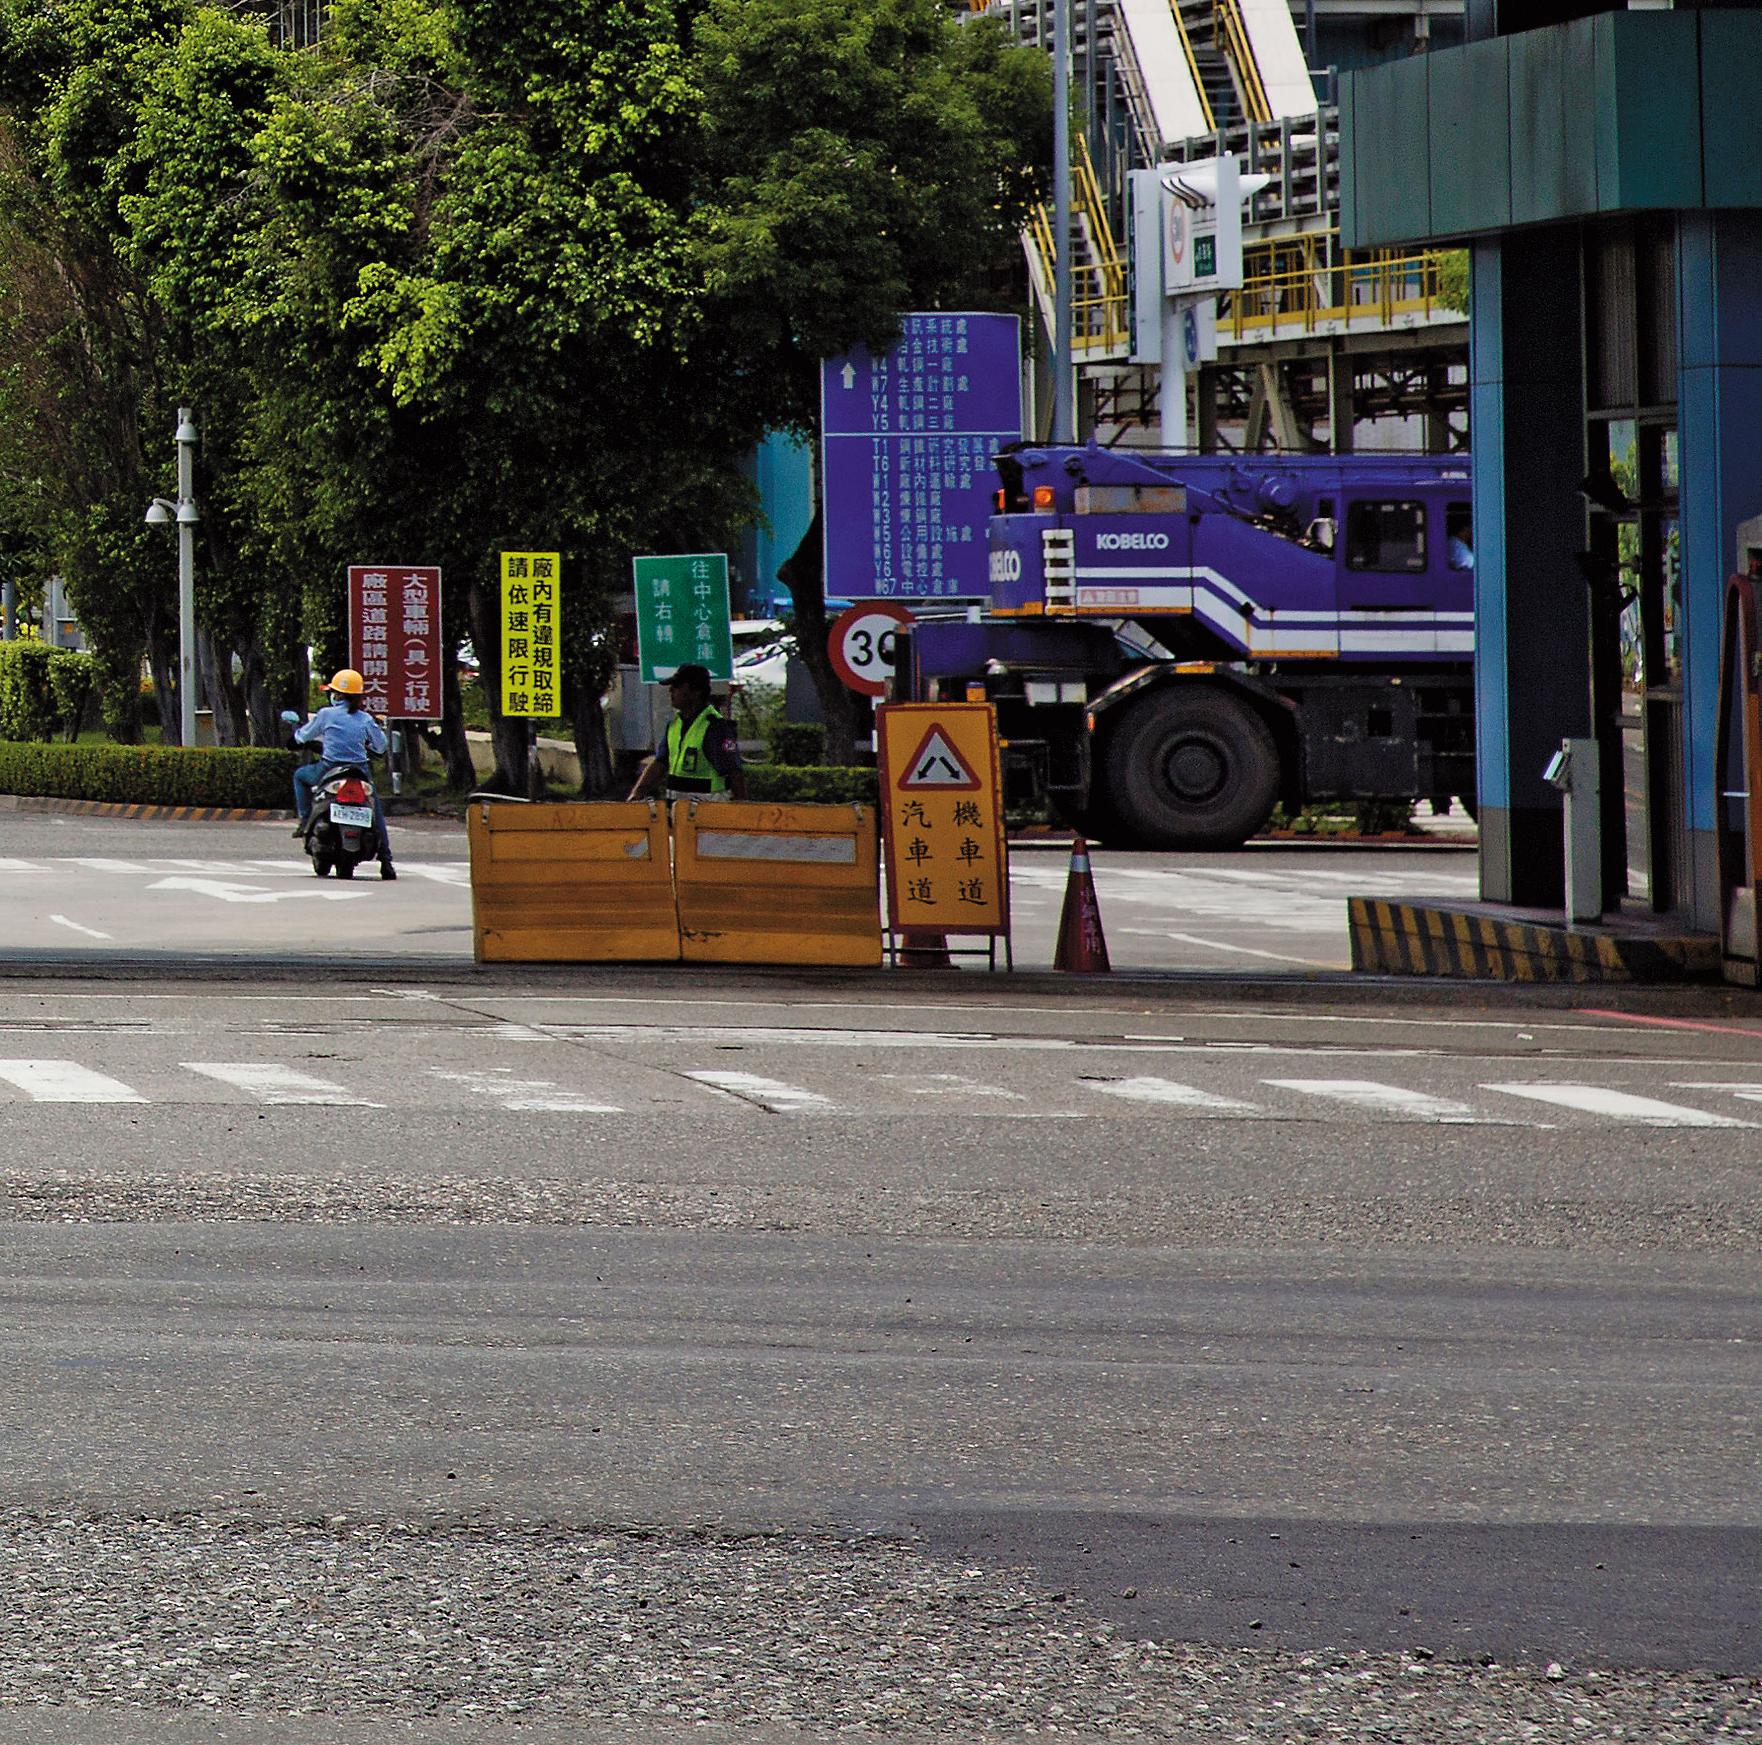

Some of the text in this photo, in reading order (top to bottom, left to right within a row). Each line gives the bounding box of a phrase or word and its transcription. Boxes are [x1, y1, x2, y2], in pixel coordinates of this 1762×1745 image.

[872, 394, 888, 411] Y4
[872, 413, 889, 430] Y5
[872, 437, 888, 454] T1
[872, 455, 890, 472] T6
[1096, 533, 1169, 550] KOBELCO
[362, 572, 389, 713] 廠區道路請開大燈
[508, 557, 529, 713] 請依速限行駛
[532, 557, 553, 713] 廠內有違規取締
[652, 578, 674, 643] 請右轉
[691, 560, 714, 660] 往中心倉庫
[851, 629, 896, 666] 30
[900, 800, 937, 905] 汽車道
[952, 800, 988, 905] 機車道
